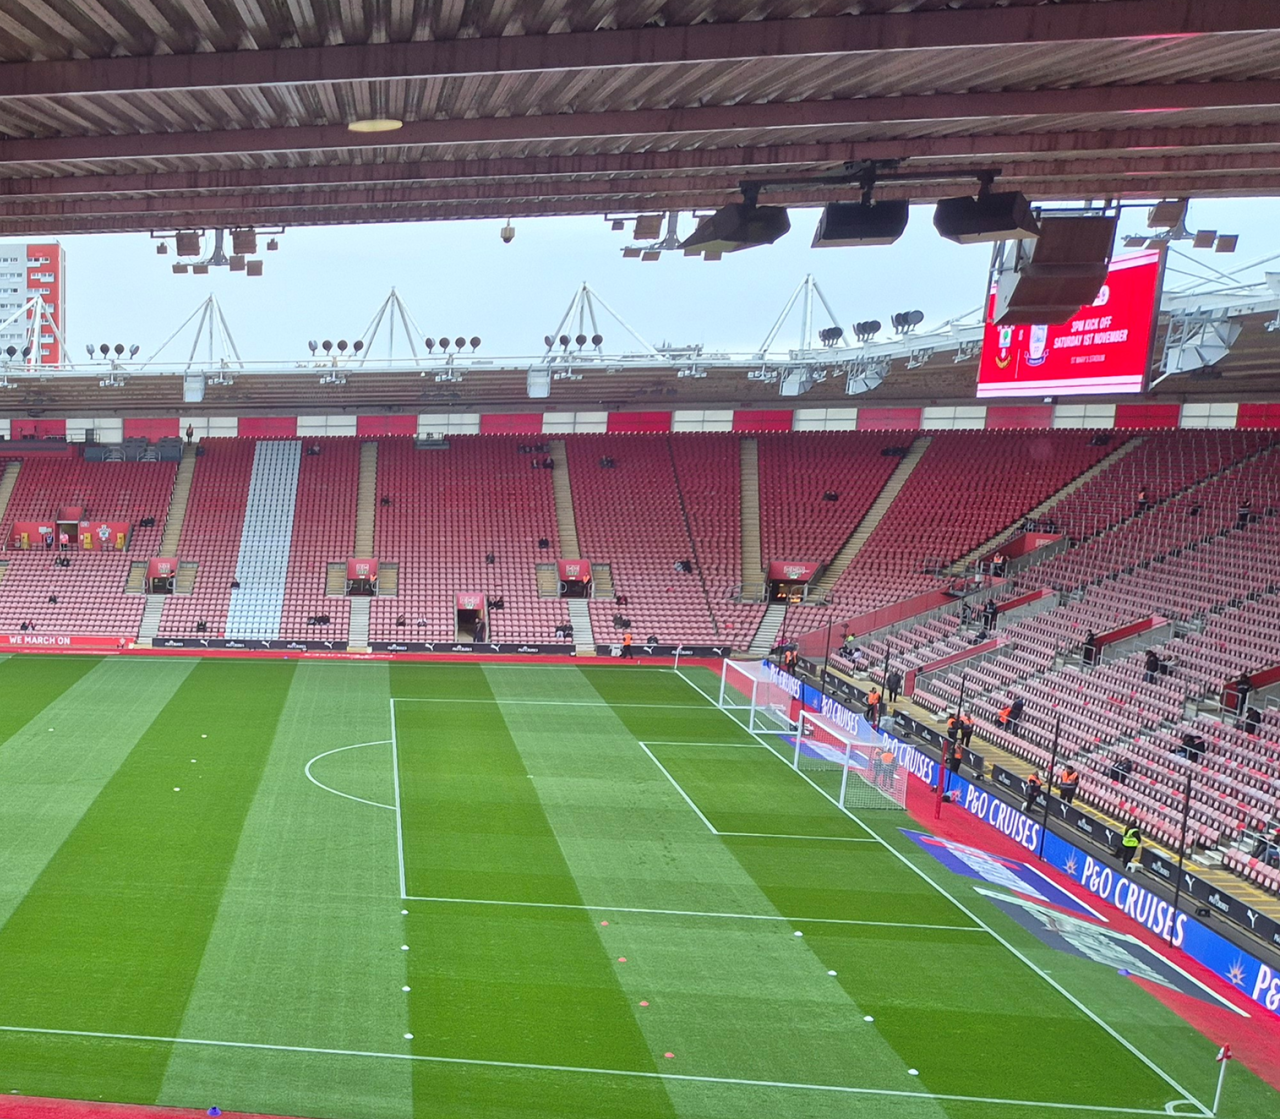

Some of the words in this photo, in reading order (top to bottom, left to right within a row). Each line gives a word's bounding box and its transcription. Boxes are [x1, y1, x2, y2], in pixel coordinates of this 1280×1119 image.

[1053, 334, 1083, 349] SATURDAY
[1083, 333, 1094, 346] 1ST
[1093, 329, 1128, 344] NOVEMBER
[1070, 321, 1084, 333] 3PM
[1084, 318, 1099, 330] KICK
[1099, 316, 1113, 329] OFF
[9, 636, 22, 644] WE
[24, 636, 56, 644] MARCH
[57, 636, 70, 645] ON
[832, 702, 859, 735] CRUISES
[899, 745, 934, 783] CRUISES
[965, 784, 988, 818] P&O
[989, 800, 1040, 851] CRUISES
[1081, 856, 1113, 899] P&O
[1114, 878, 1187, 947] CRUISES
